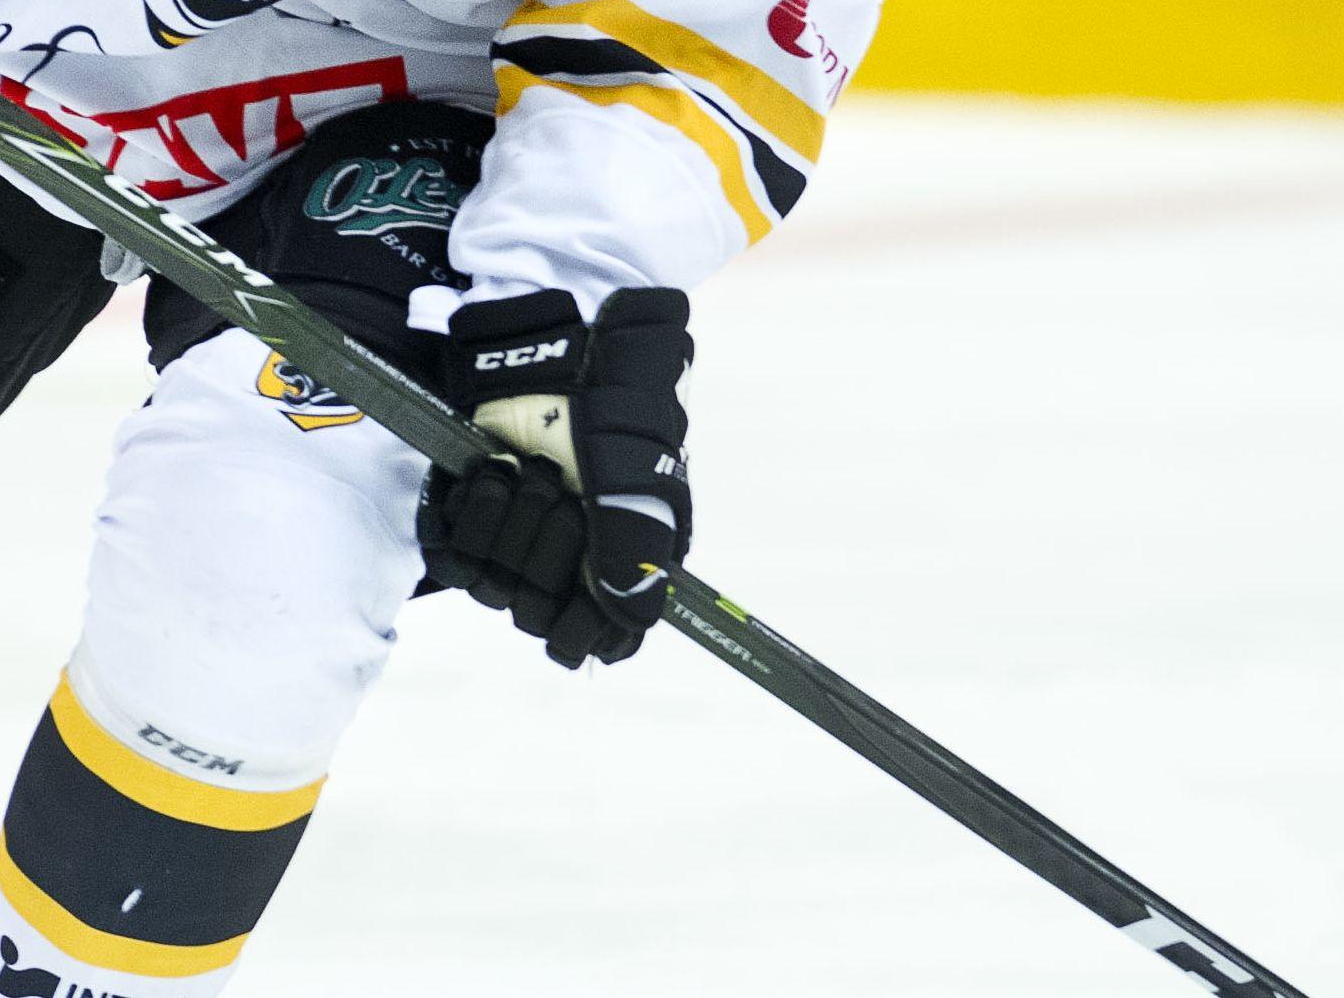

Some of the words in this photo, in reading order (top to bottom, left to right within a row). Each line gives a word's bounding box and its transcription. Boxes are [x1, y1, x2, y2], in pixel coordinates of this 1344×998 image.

[103, 174, 275, 288] CCM
[379, 233, 426, 269] BAR
[475, 338, 569, 371] CCM
[137, 721, 245, 776] CCM
